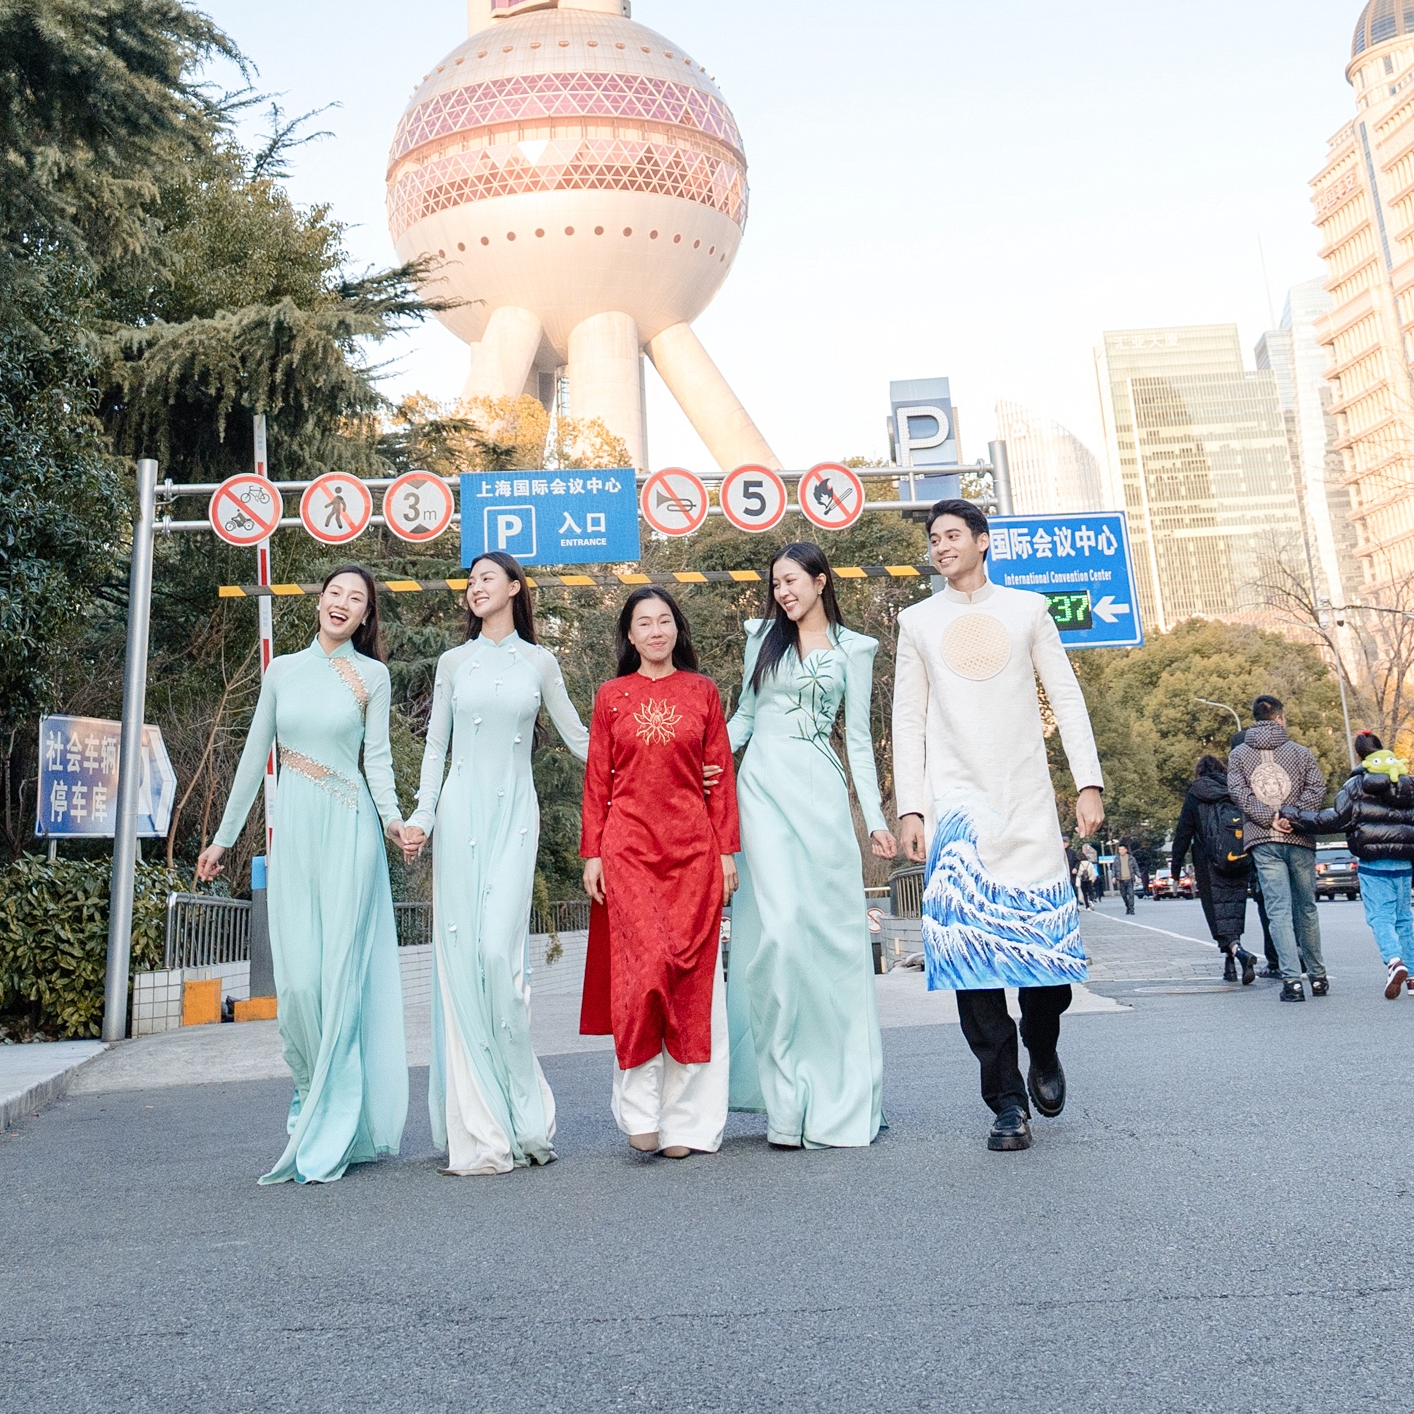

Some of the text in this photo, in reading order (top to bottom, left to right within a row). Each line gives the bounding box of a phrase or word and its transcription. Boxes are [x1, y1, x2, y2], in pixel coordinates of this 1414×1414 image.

[1114, 332, 1179, 350] 汇亚大厦
[896, 405, 950, 467] P
[476, 476, 622, 498] 上海国际会议中心
[742, 480, 767, 517] 5
[497, 514, 523, 550] P
[558, 511, 606, 534] 入口
[560, 537, 607, 547] ENTRANCE
[989, 524, 1118, 562] 国际会议中心
[1004, 568, 1112, 586] International Convention Center
[45, 730, 117, 776] 社会车辆
[50, 779, 108, 824] 停车库
